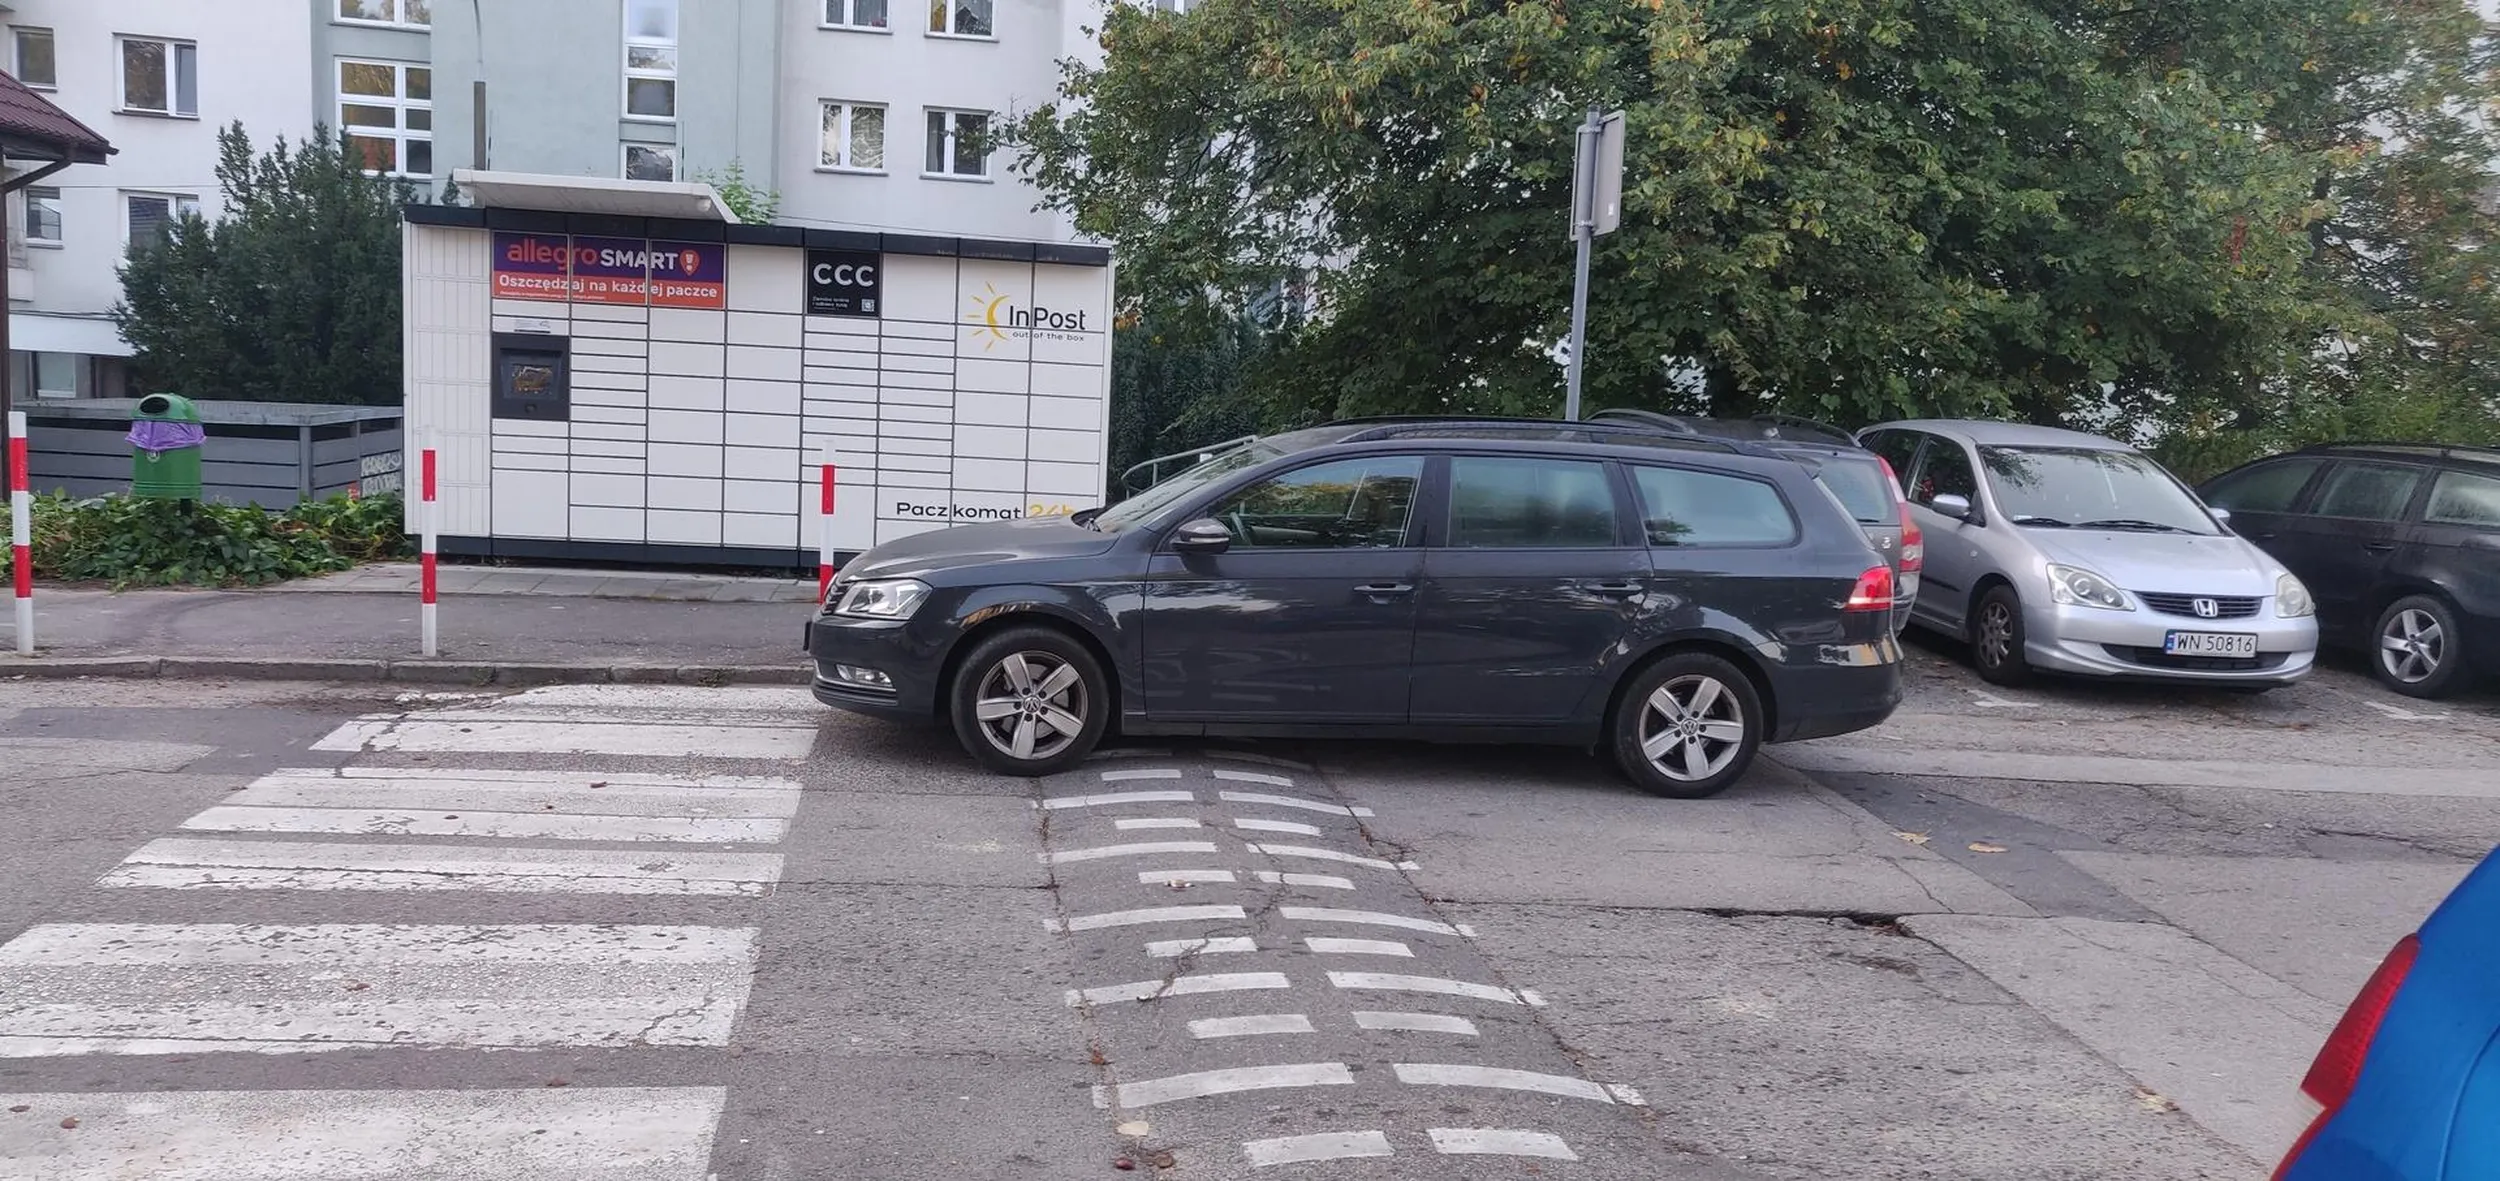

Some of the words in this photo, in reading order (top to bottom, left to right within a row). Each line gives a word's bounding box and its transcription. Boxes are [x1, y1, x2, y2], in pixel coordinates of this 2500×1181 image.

[507, 238, 598, 270] allegro
[499, 274, 585, 293] Oszczędzaj
[589, 280, 607, 292] na
[612, 280, 663, 297] każdej
[666, 286, 718, 299] paczce
[813, 263, 875, 287] CCC
[1009, 305, 1086, 330] InPost
[1033, 331, 1044, 339] of
[1047, 332, 1063, 340] the
[1066, 334, 1085, 342] box
[2177, 635, 2201, 650] WN
[2206, 636, 2253, 653] 50816
